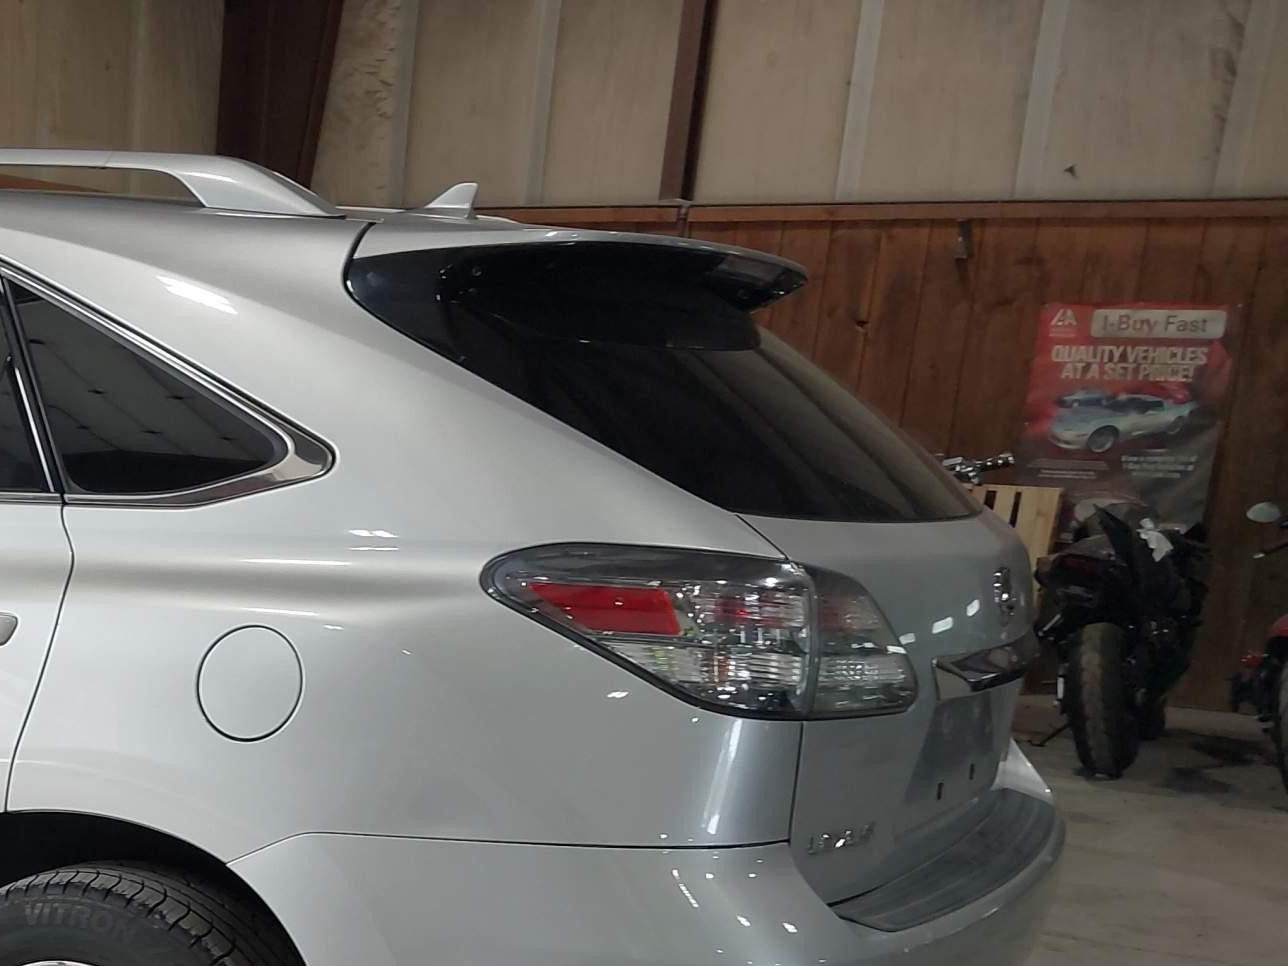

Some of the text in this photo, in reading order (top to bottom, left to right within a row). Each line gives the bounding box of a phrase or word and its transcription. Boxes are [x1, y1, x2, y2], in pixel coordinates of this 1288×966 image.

[1102, 314, 1208, 334] I-Buy Fast
[1051, 345, 1209, 366] QUALITY VEHICLES
[1060, 363, 1087, 379] AT
[1086, 363, 1100, 380] A
[1103, 363, 1136, 381] SET
